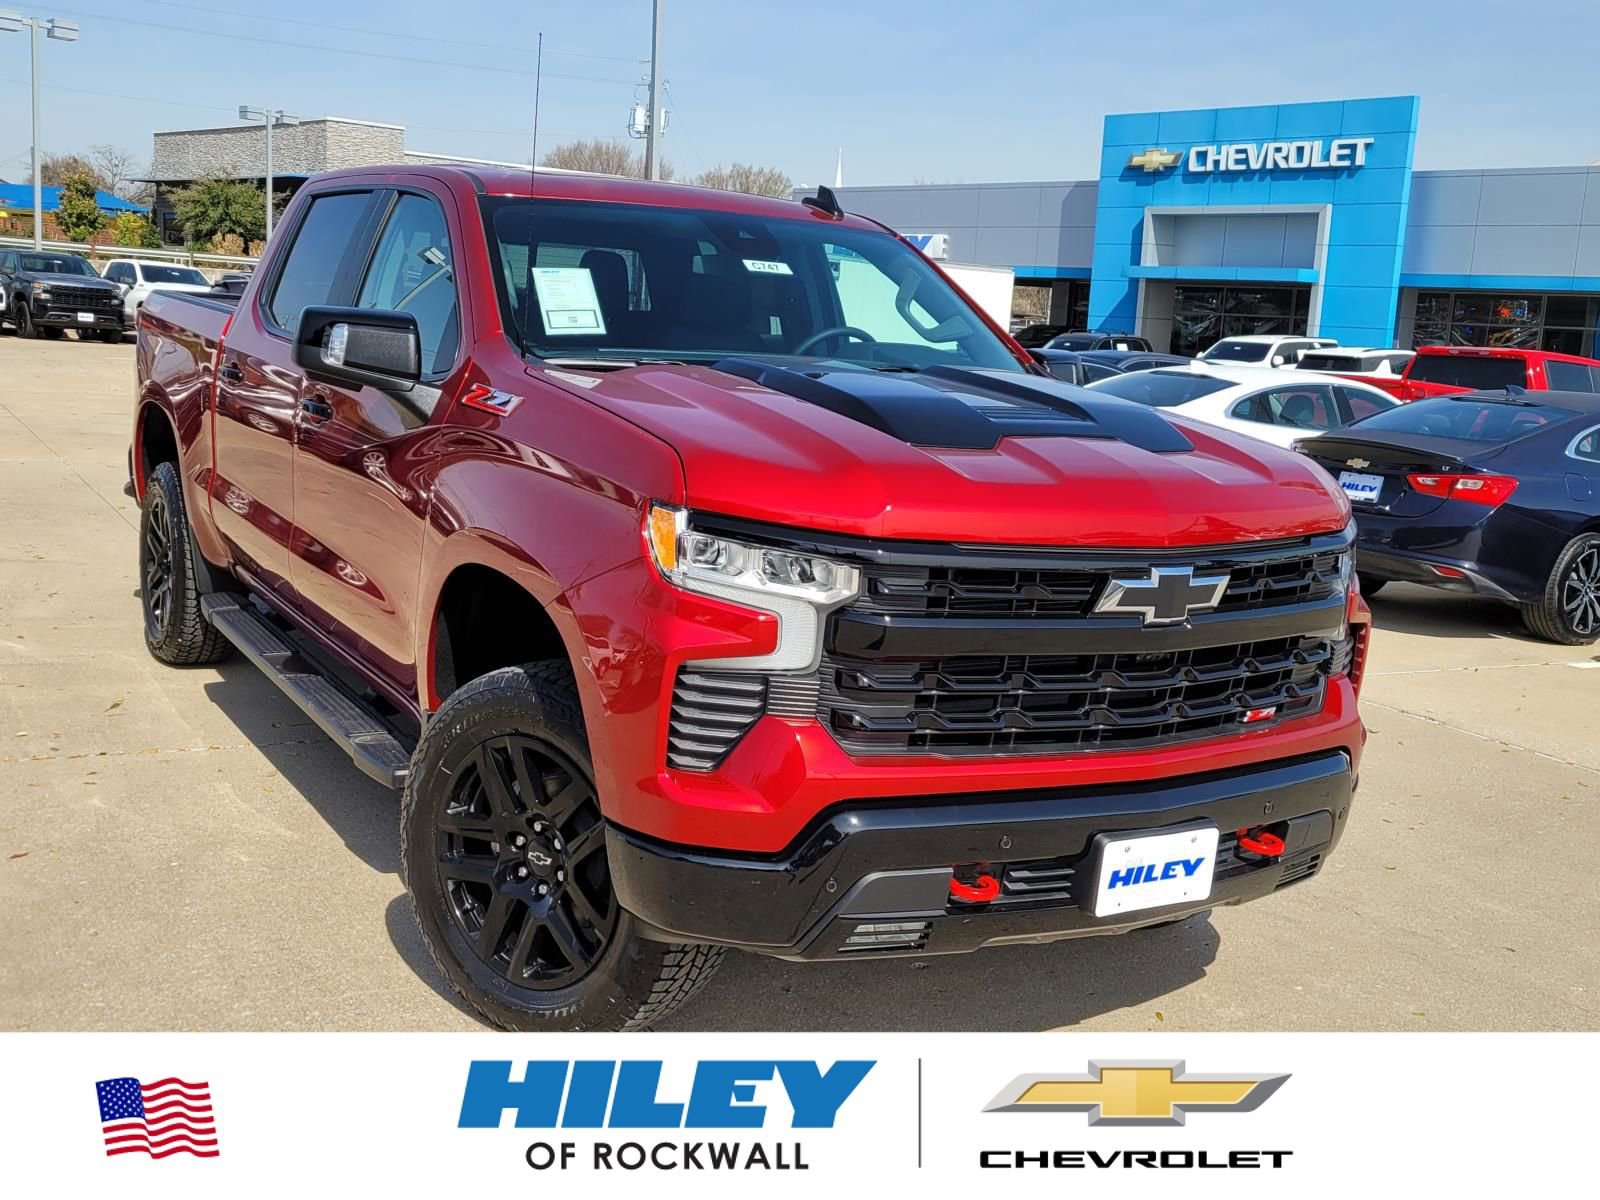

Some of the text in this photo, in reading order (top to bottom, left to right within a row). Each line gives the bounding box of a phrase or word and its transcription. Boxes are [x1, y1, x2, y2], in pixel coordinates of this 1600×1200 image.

[1188, 138, 1374, 172] CHEVROLET
[1341, 482, 1377, 492] HILEY
[1107, 857, 1205, 889] HILEY
